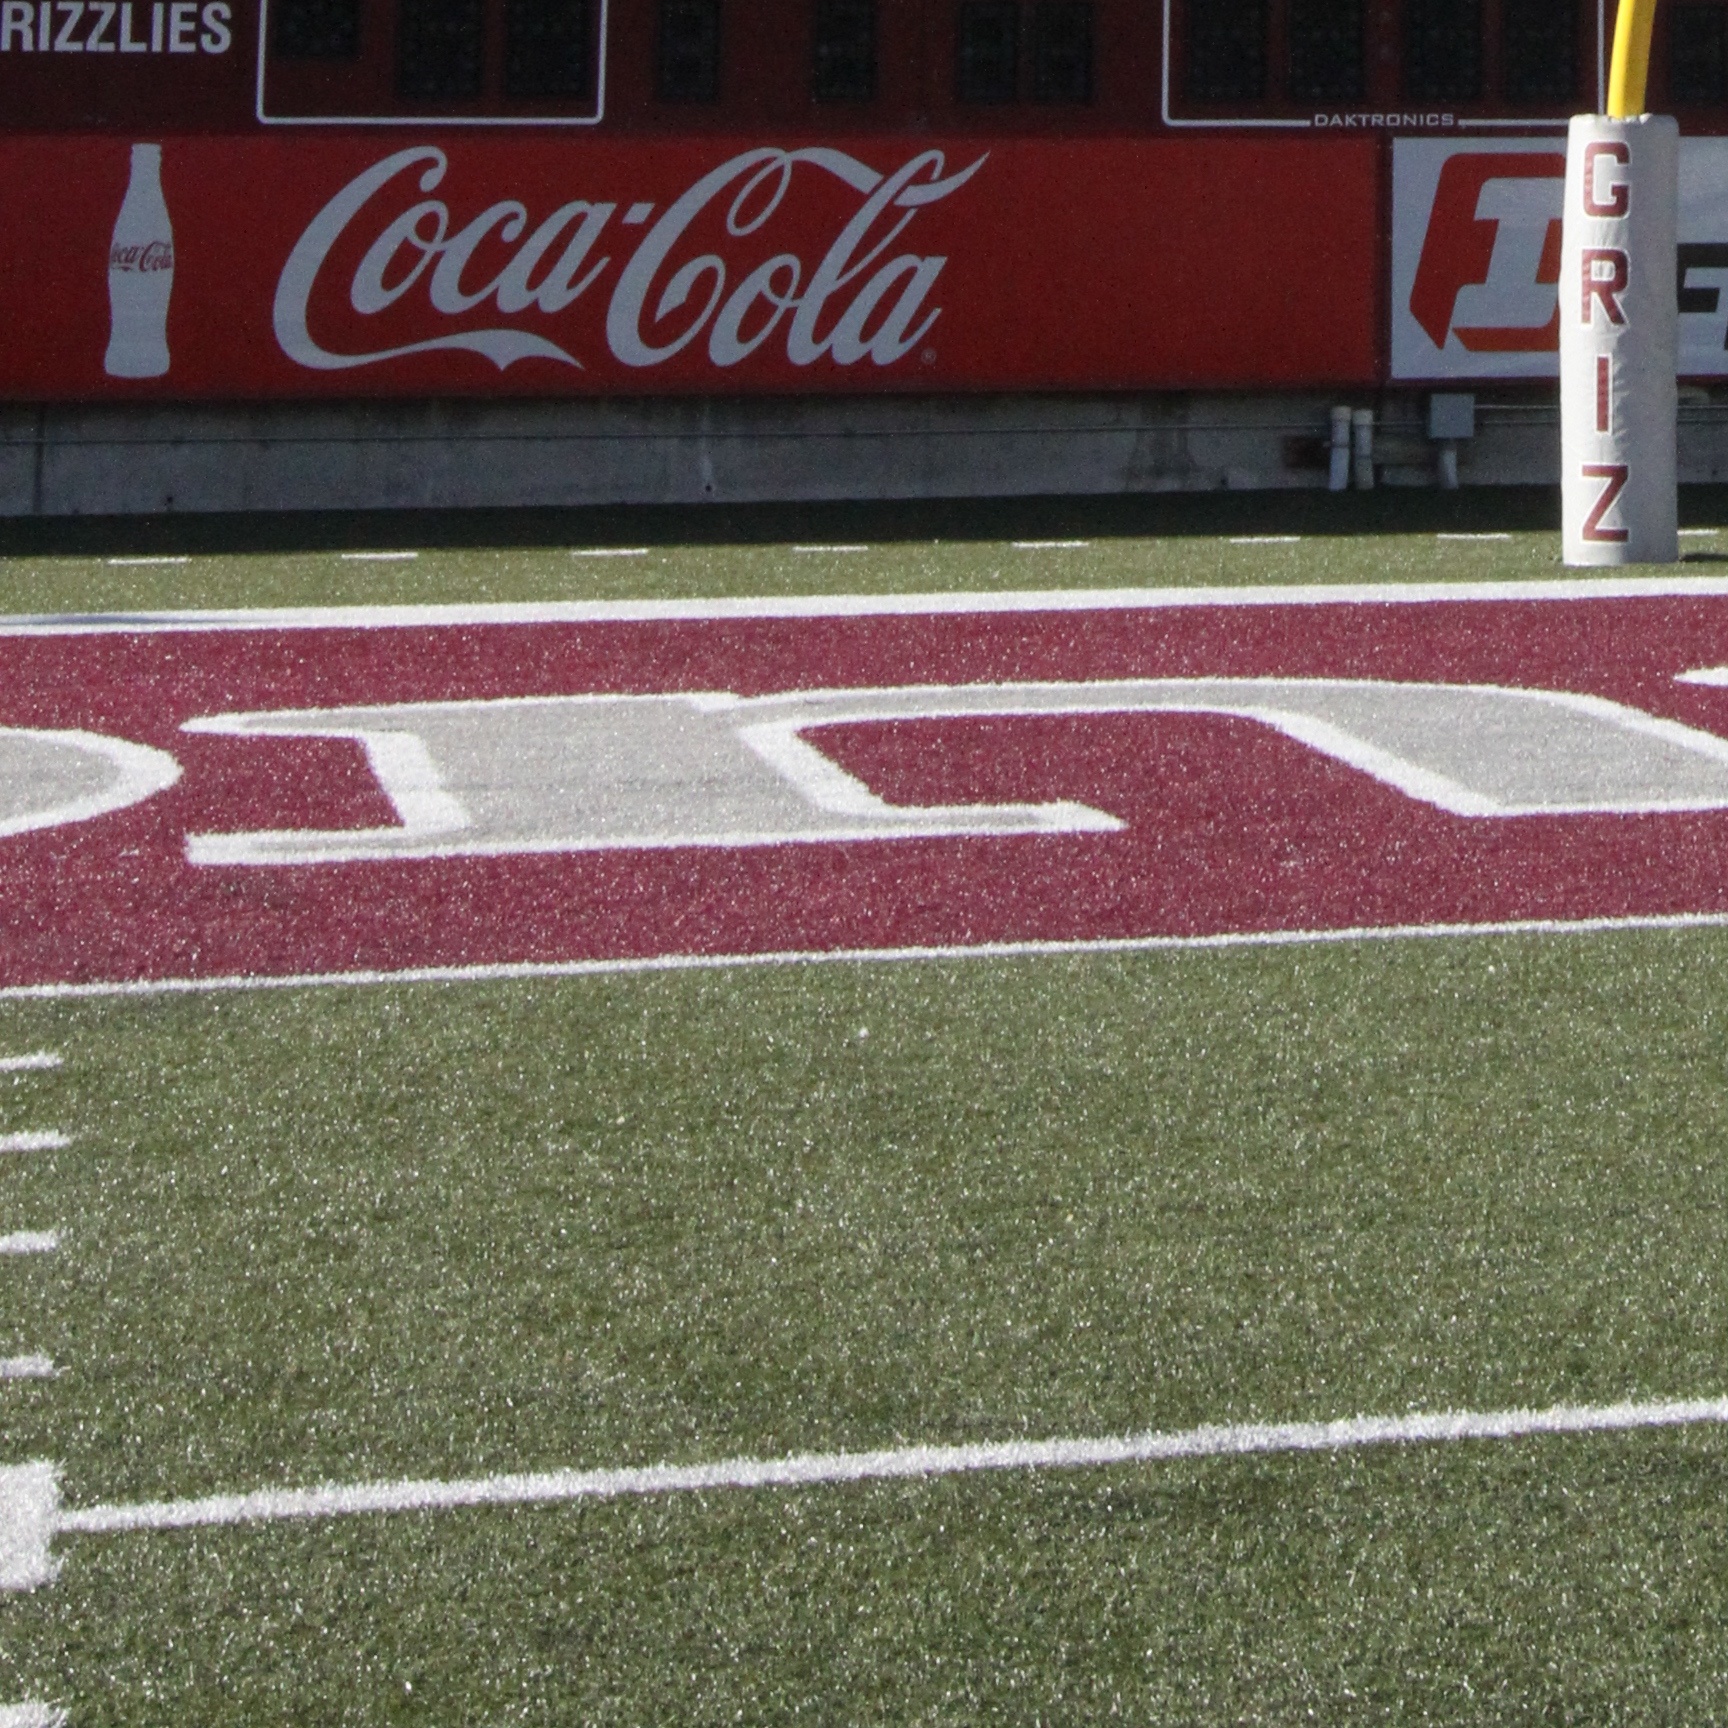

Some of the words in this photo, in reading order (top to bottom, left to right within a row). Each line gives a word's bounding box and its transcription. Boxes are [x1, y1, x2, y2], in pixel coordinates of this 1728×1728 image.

[1313, 113, 1455, 128] DAKTRONICS
[272, 144, 990, 371] Coca-Cola
[1580, 141, 1631, 542] GRIZ
